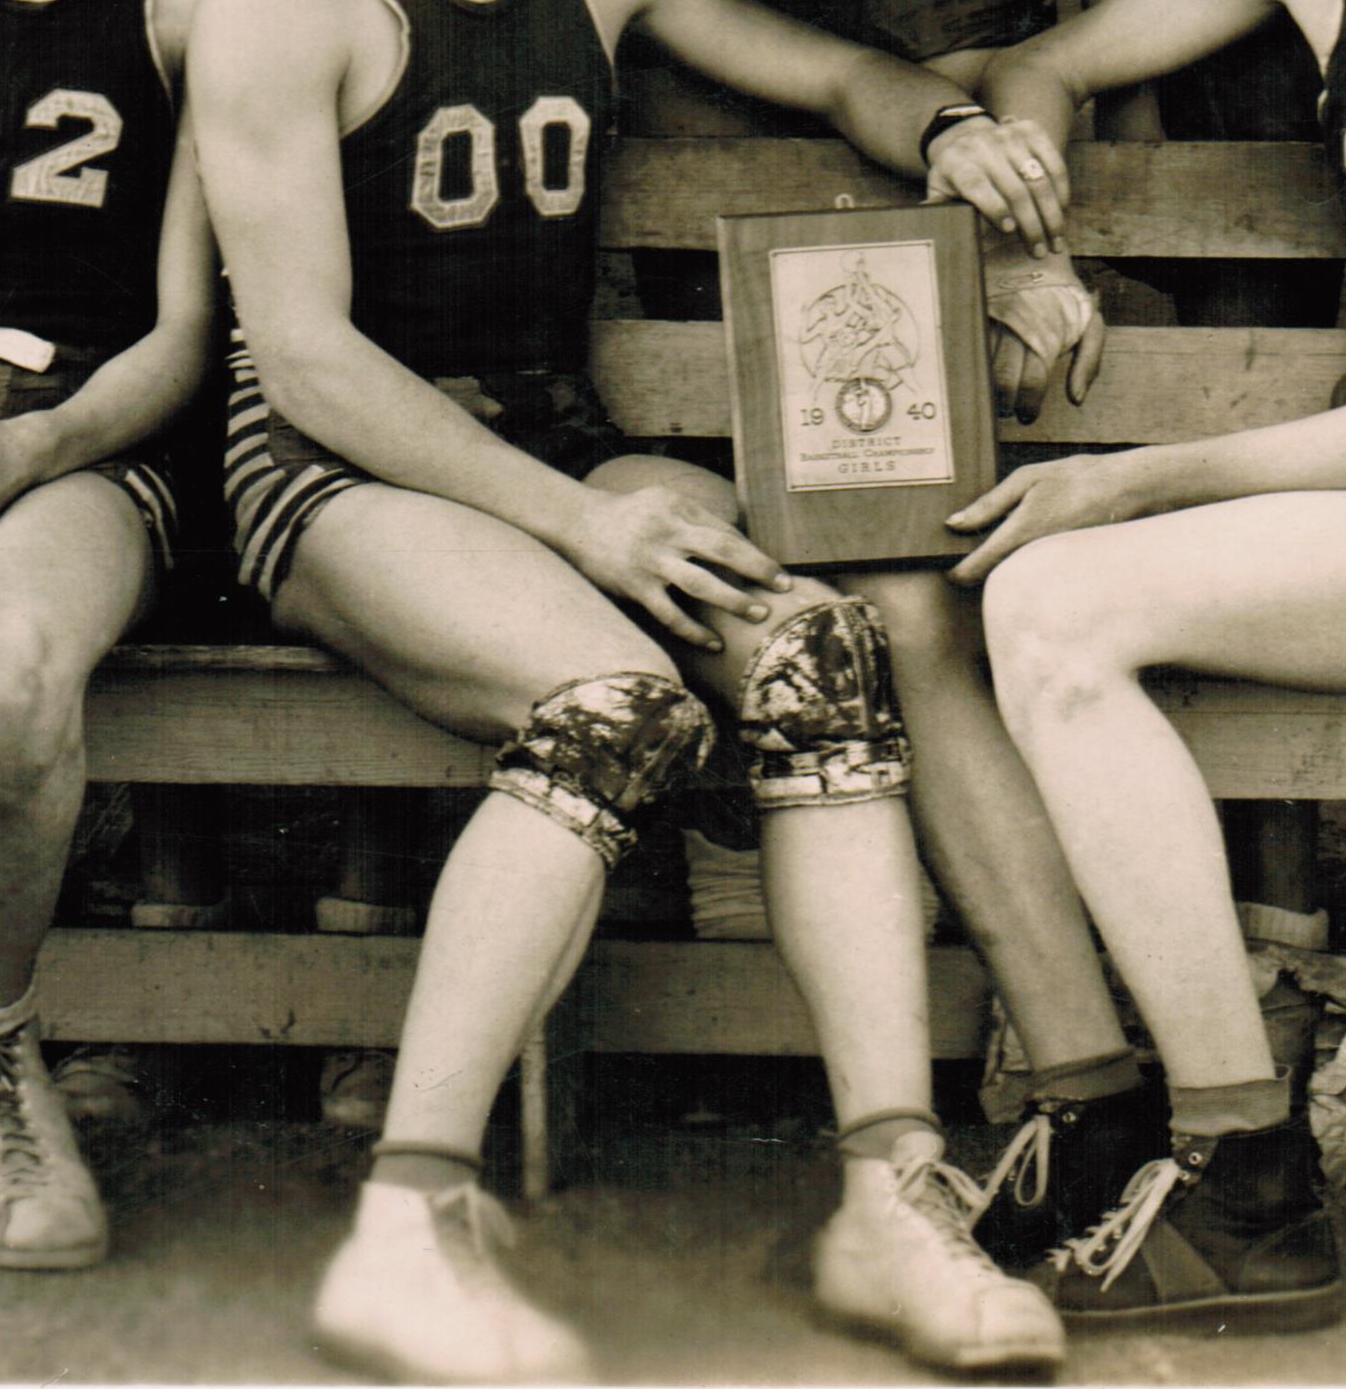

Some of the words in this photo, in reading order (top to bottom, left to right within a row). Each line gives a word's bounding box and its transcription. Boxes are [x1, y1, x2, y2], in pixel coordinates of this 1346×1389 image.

[410, 95, 591, 230] 00
[800, 407, 824, 426] 19
[906, 401, 937, 420] 40
[831, 435, 901, 449] DISTRICT
[837, 460, 896, 474] GIRLS
